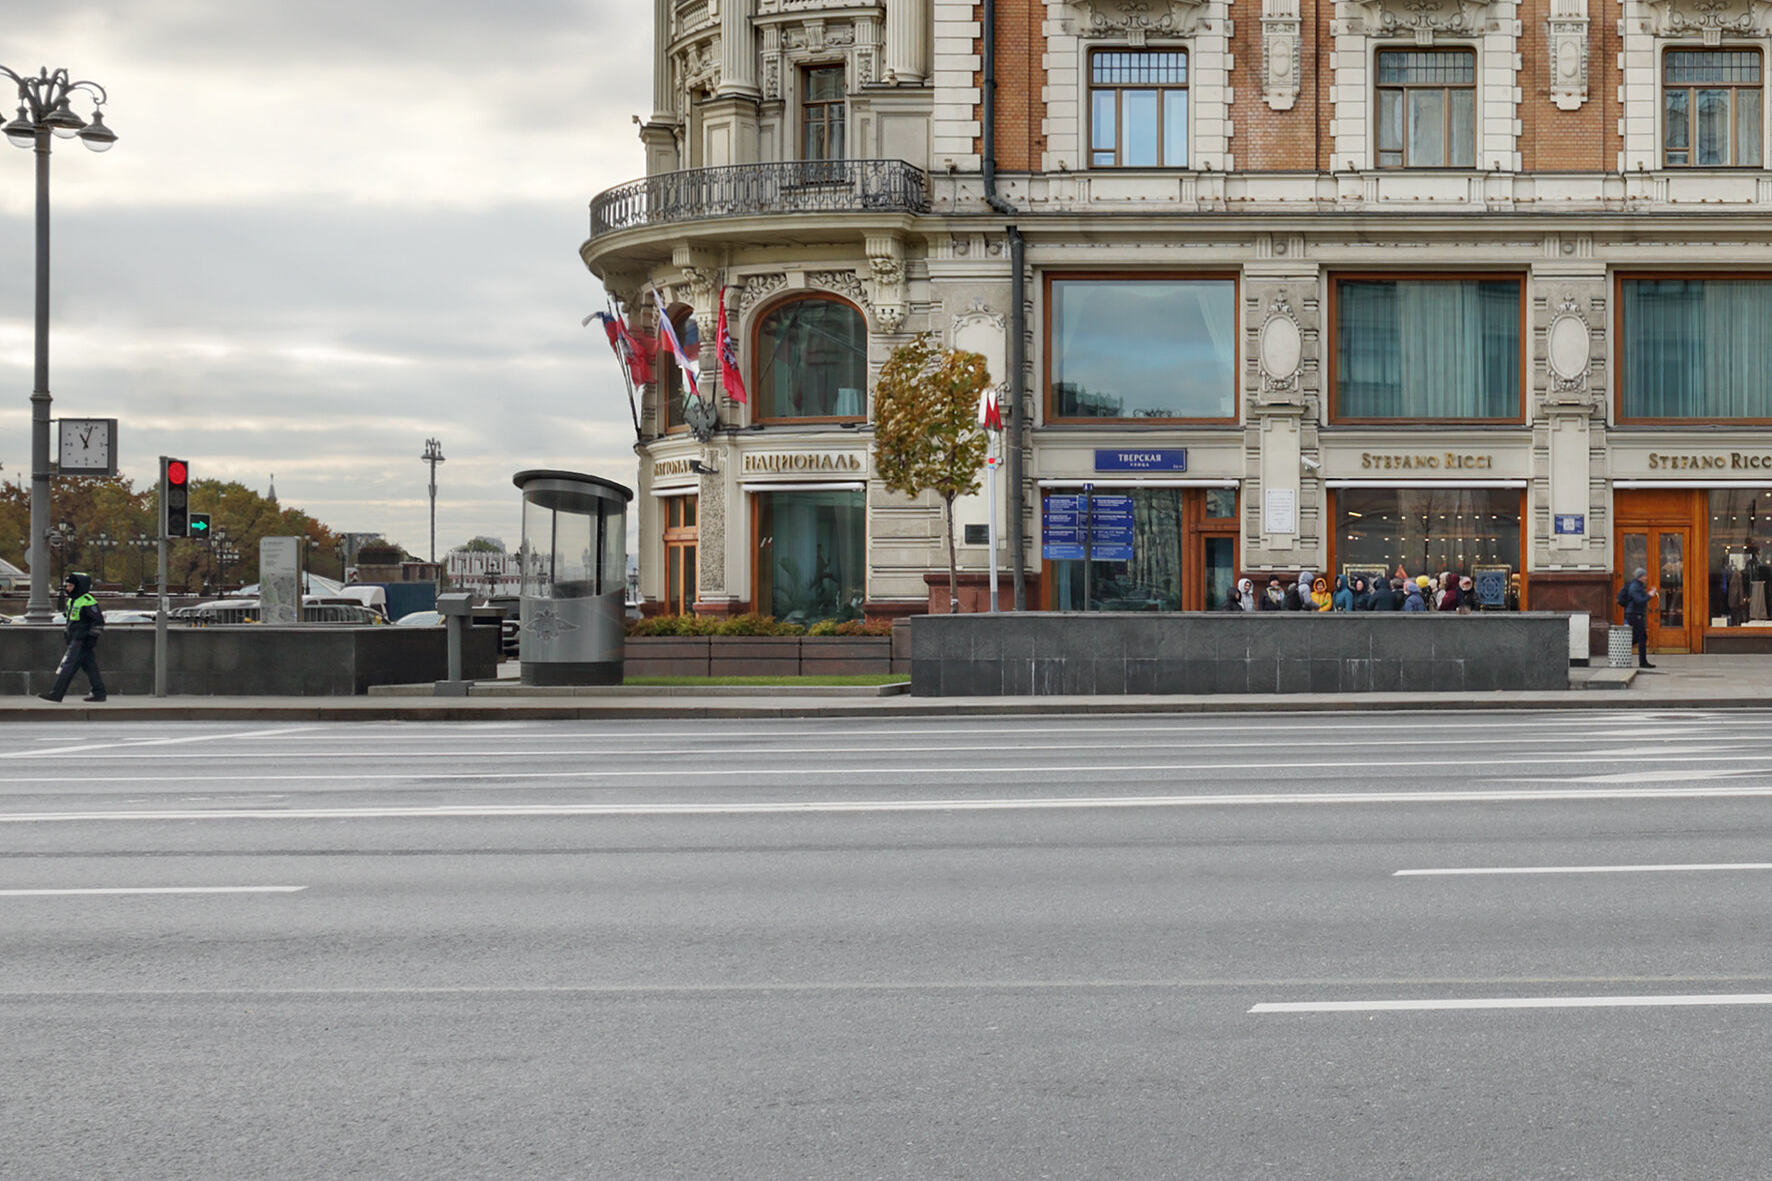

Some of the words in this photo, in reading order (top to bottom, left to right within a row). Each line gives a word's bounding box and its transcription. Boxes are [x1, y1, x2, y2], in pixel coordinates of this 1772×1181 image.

[745, 454, 861, 471] НАЦИОНАЛЬ
[1118, 454, 1161, 462] ТВЕРСКАЯ
[1361, 452, 1439, 469] STEFANO
[1444, 452, 1492, 469] RICCI
[1648, 452, 1726, 469] STEFANO
